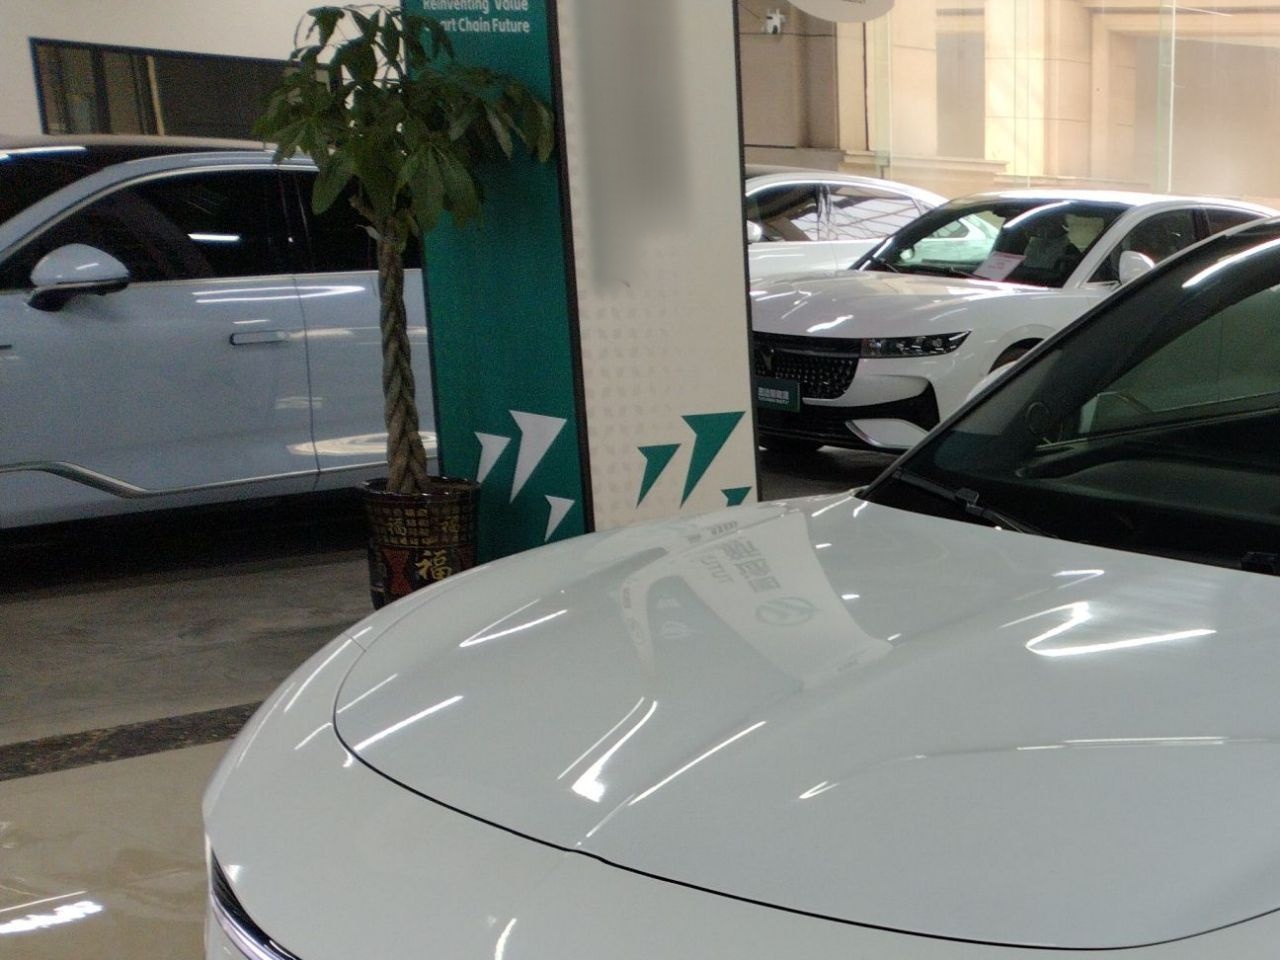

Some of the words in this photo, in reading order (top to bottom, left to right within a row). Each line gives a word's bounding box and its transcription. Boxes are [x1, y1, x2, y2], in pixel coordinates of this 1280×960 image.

[423, 0, 490, 14] Reinventing
[494, 0, 529, 11] Value
[458, 16, 490, 32] Chain
[492, 18, 530, 33] Future
[414, 549, 452, 581] 福
